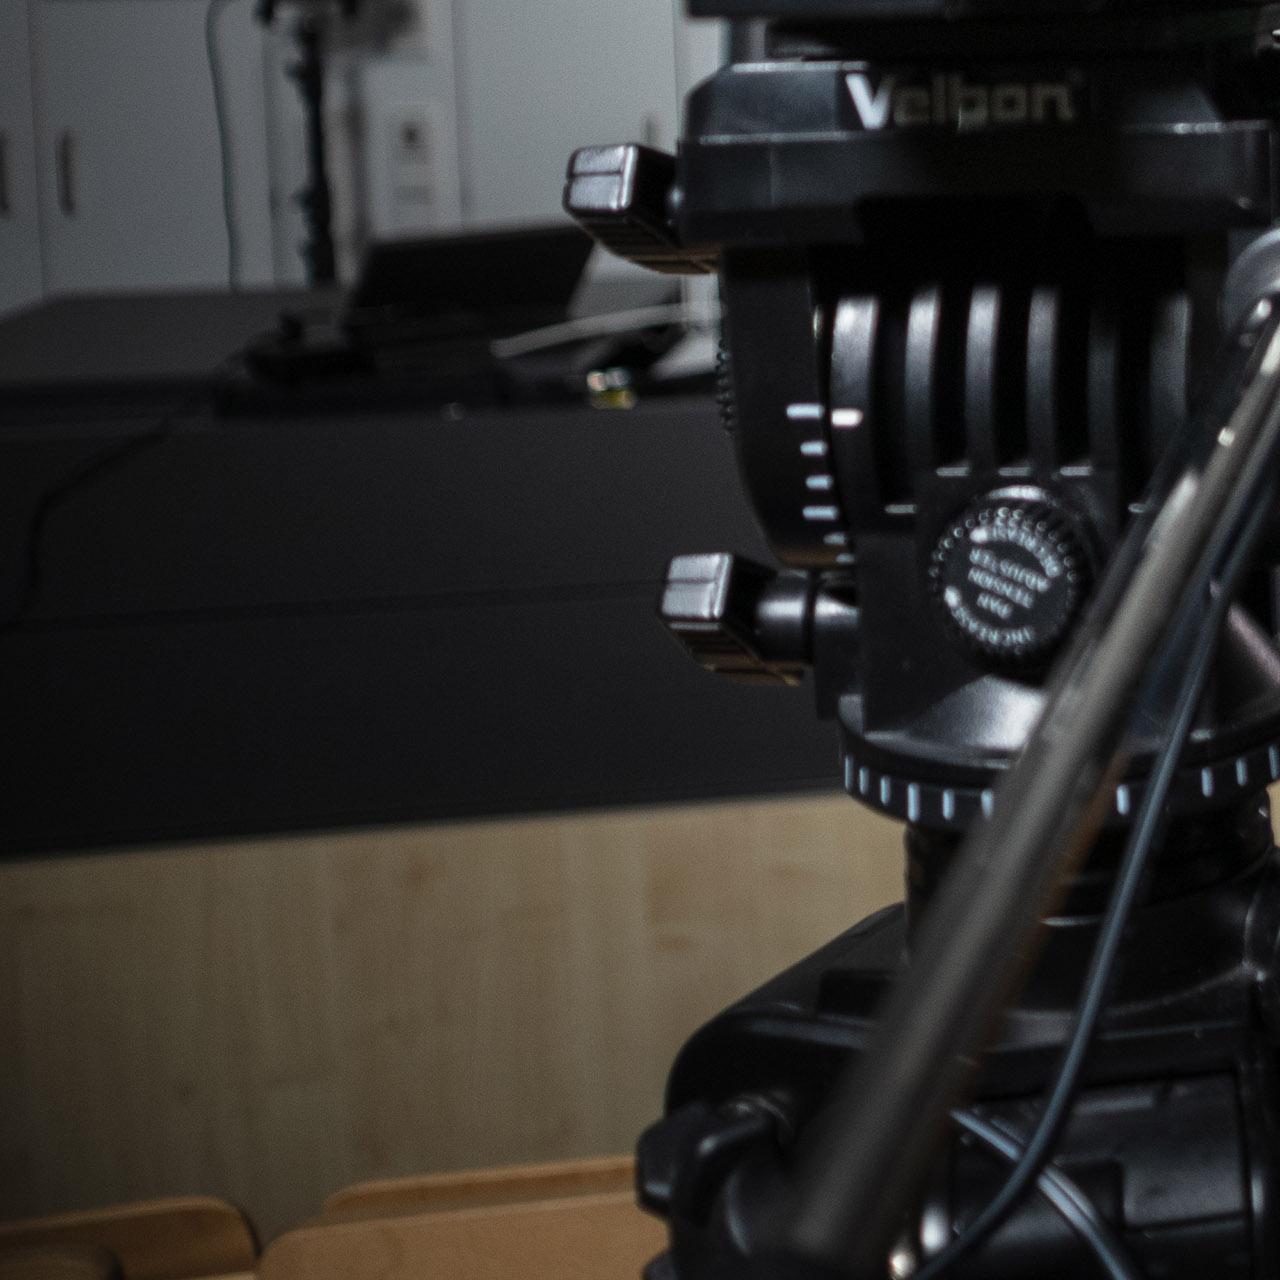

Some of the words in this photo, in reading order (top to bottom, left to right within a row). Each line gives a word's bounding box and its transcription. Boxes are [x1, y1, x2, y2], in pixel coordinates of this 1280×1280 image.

[968, 567, 1034, 608] TENSION
[970, 548, 1050, 592] ADJUSTER
[977, 592, 1013, 619] PAN
